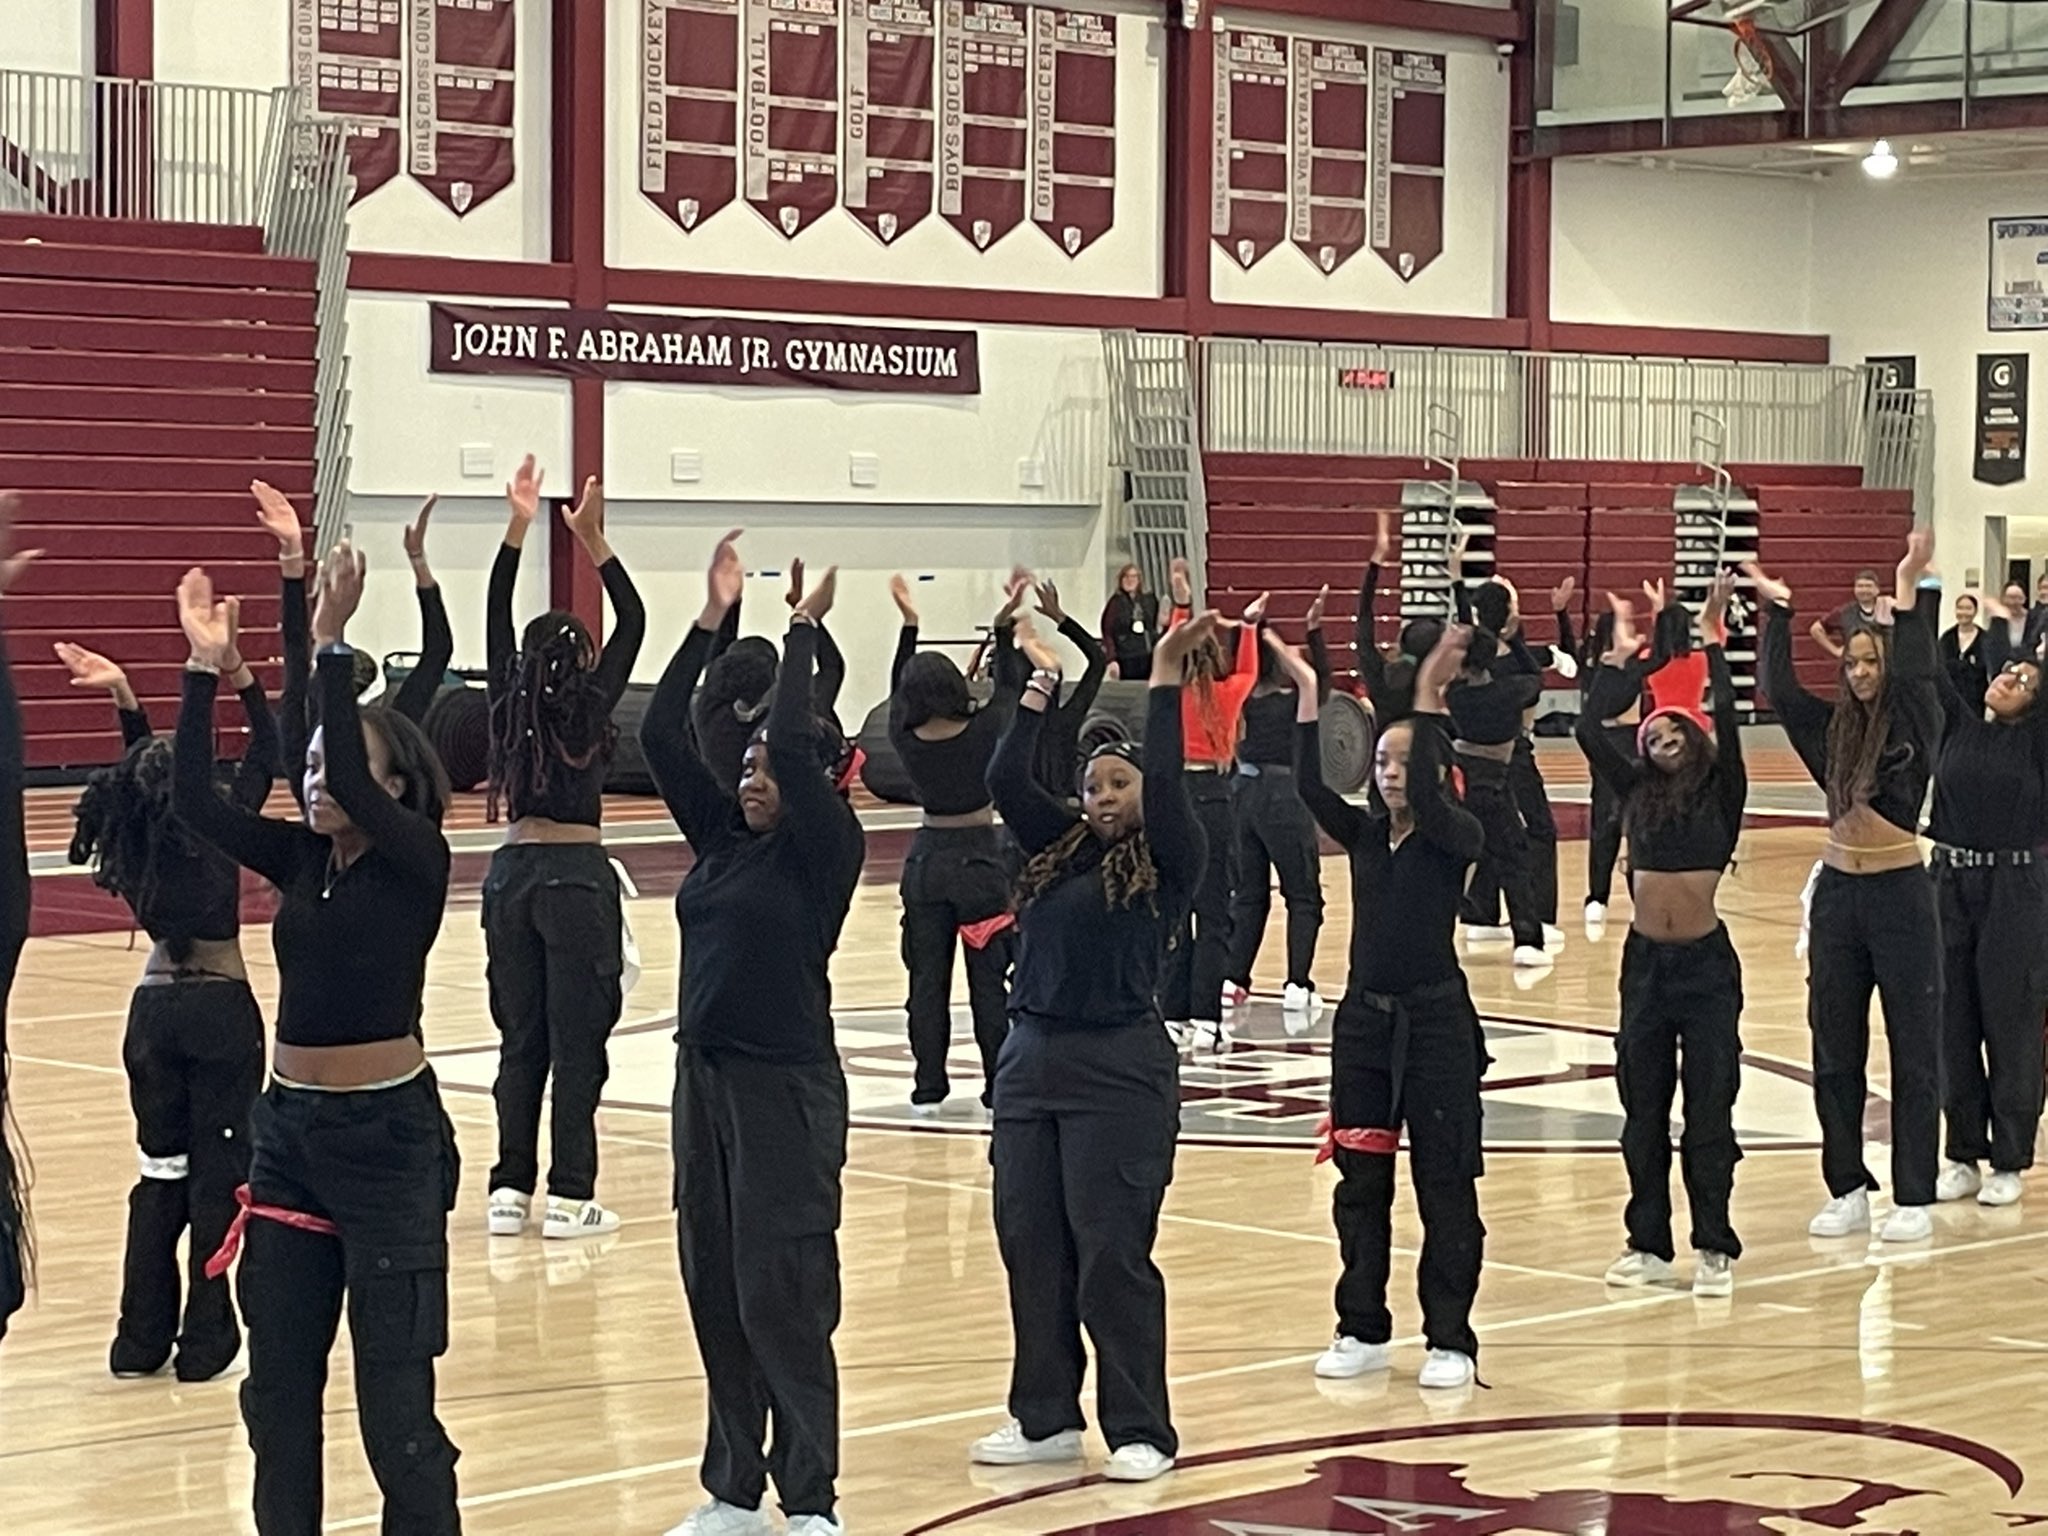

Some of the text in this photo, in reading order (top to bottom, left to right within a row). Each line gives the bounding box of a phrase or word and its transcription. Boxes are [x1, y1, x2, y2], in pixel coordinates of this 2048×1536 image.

[416, 58, 431, 114] CROSS
[647, 1, 663, 170] FIELD HOCKEY
[750, 32, 767, 158] FOOTBALL
[946, 36, 960, 129] SOCCER
[1038, 43, 1052, 132] SOCCER
[851, 84, 866, 139] GOLF
[1297, 68, 1310, 181] VOLLEYBALL
[416, 119, 431, 171] GIRLS
[946, 137, 960, 192] BOYS
[1038, 139, 1051, 208] GIRLS
[1297, 186, 1309, 236] GIRLS
[451, 322, 959, 378] JOHN F. ABRAHAM JR. GYMNASIUM
[1994, 365, 2011, 386] G
